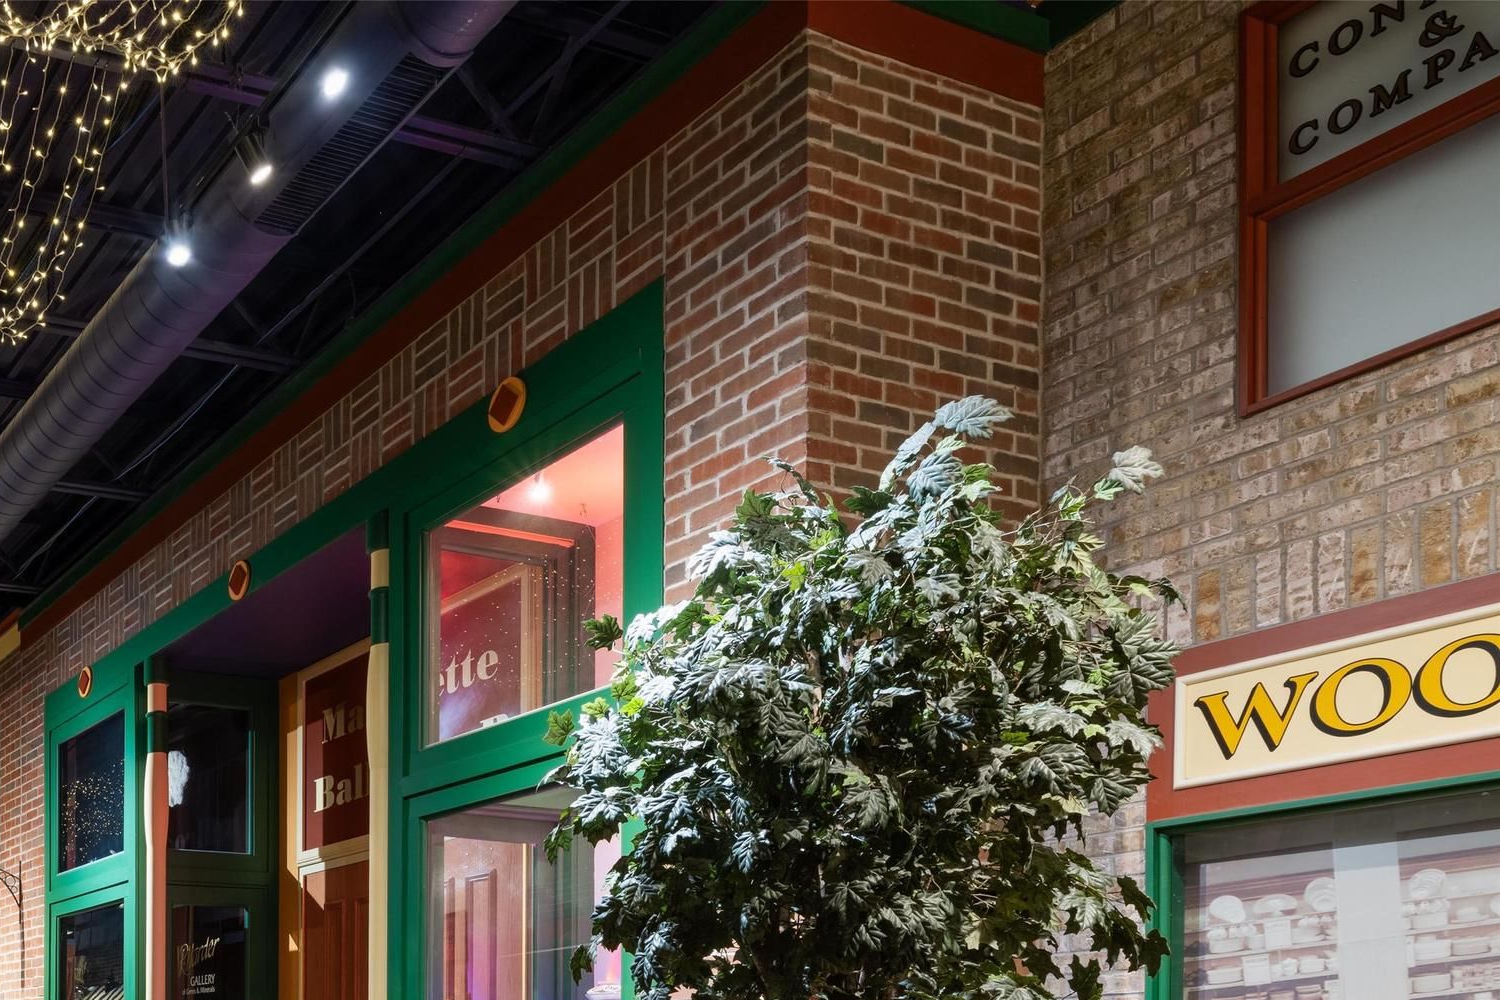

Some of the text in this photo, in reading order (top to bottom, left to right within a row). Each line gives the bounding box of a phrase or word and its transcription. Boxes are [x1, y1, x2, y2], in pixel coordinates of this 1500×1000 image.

[1289, 0, 1437, 78] CON
[1418, 10, 1466, 48] &
[1288, 31, 1500, 155] COMPA
[1193, 632, 1500, 760] WOO
[190, 973, 216, 987] GALLERY
